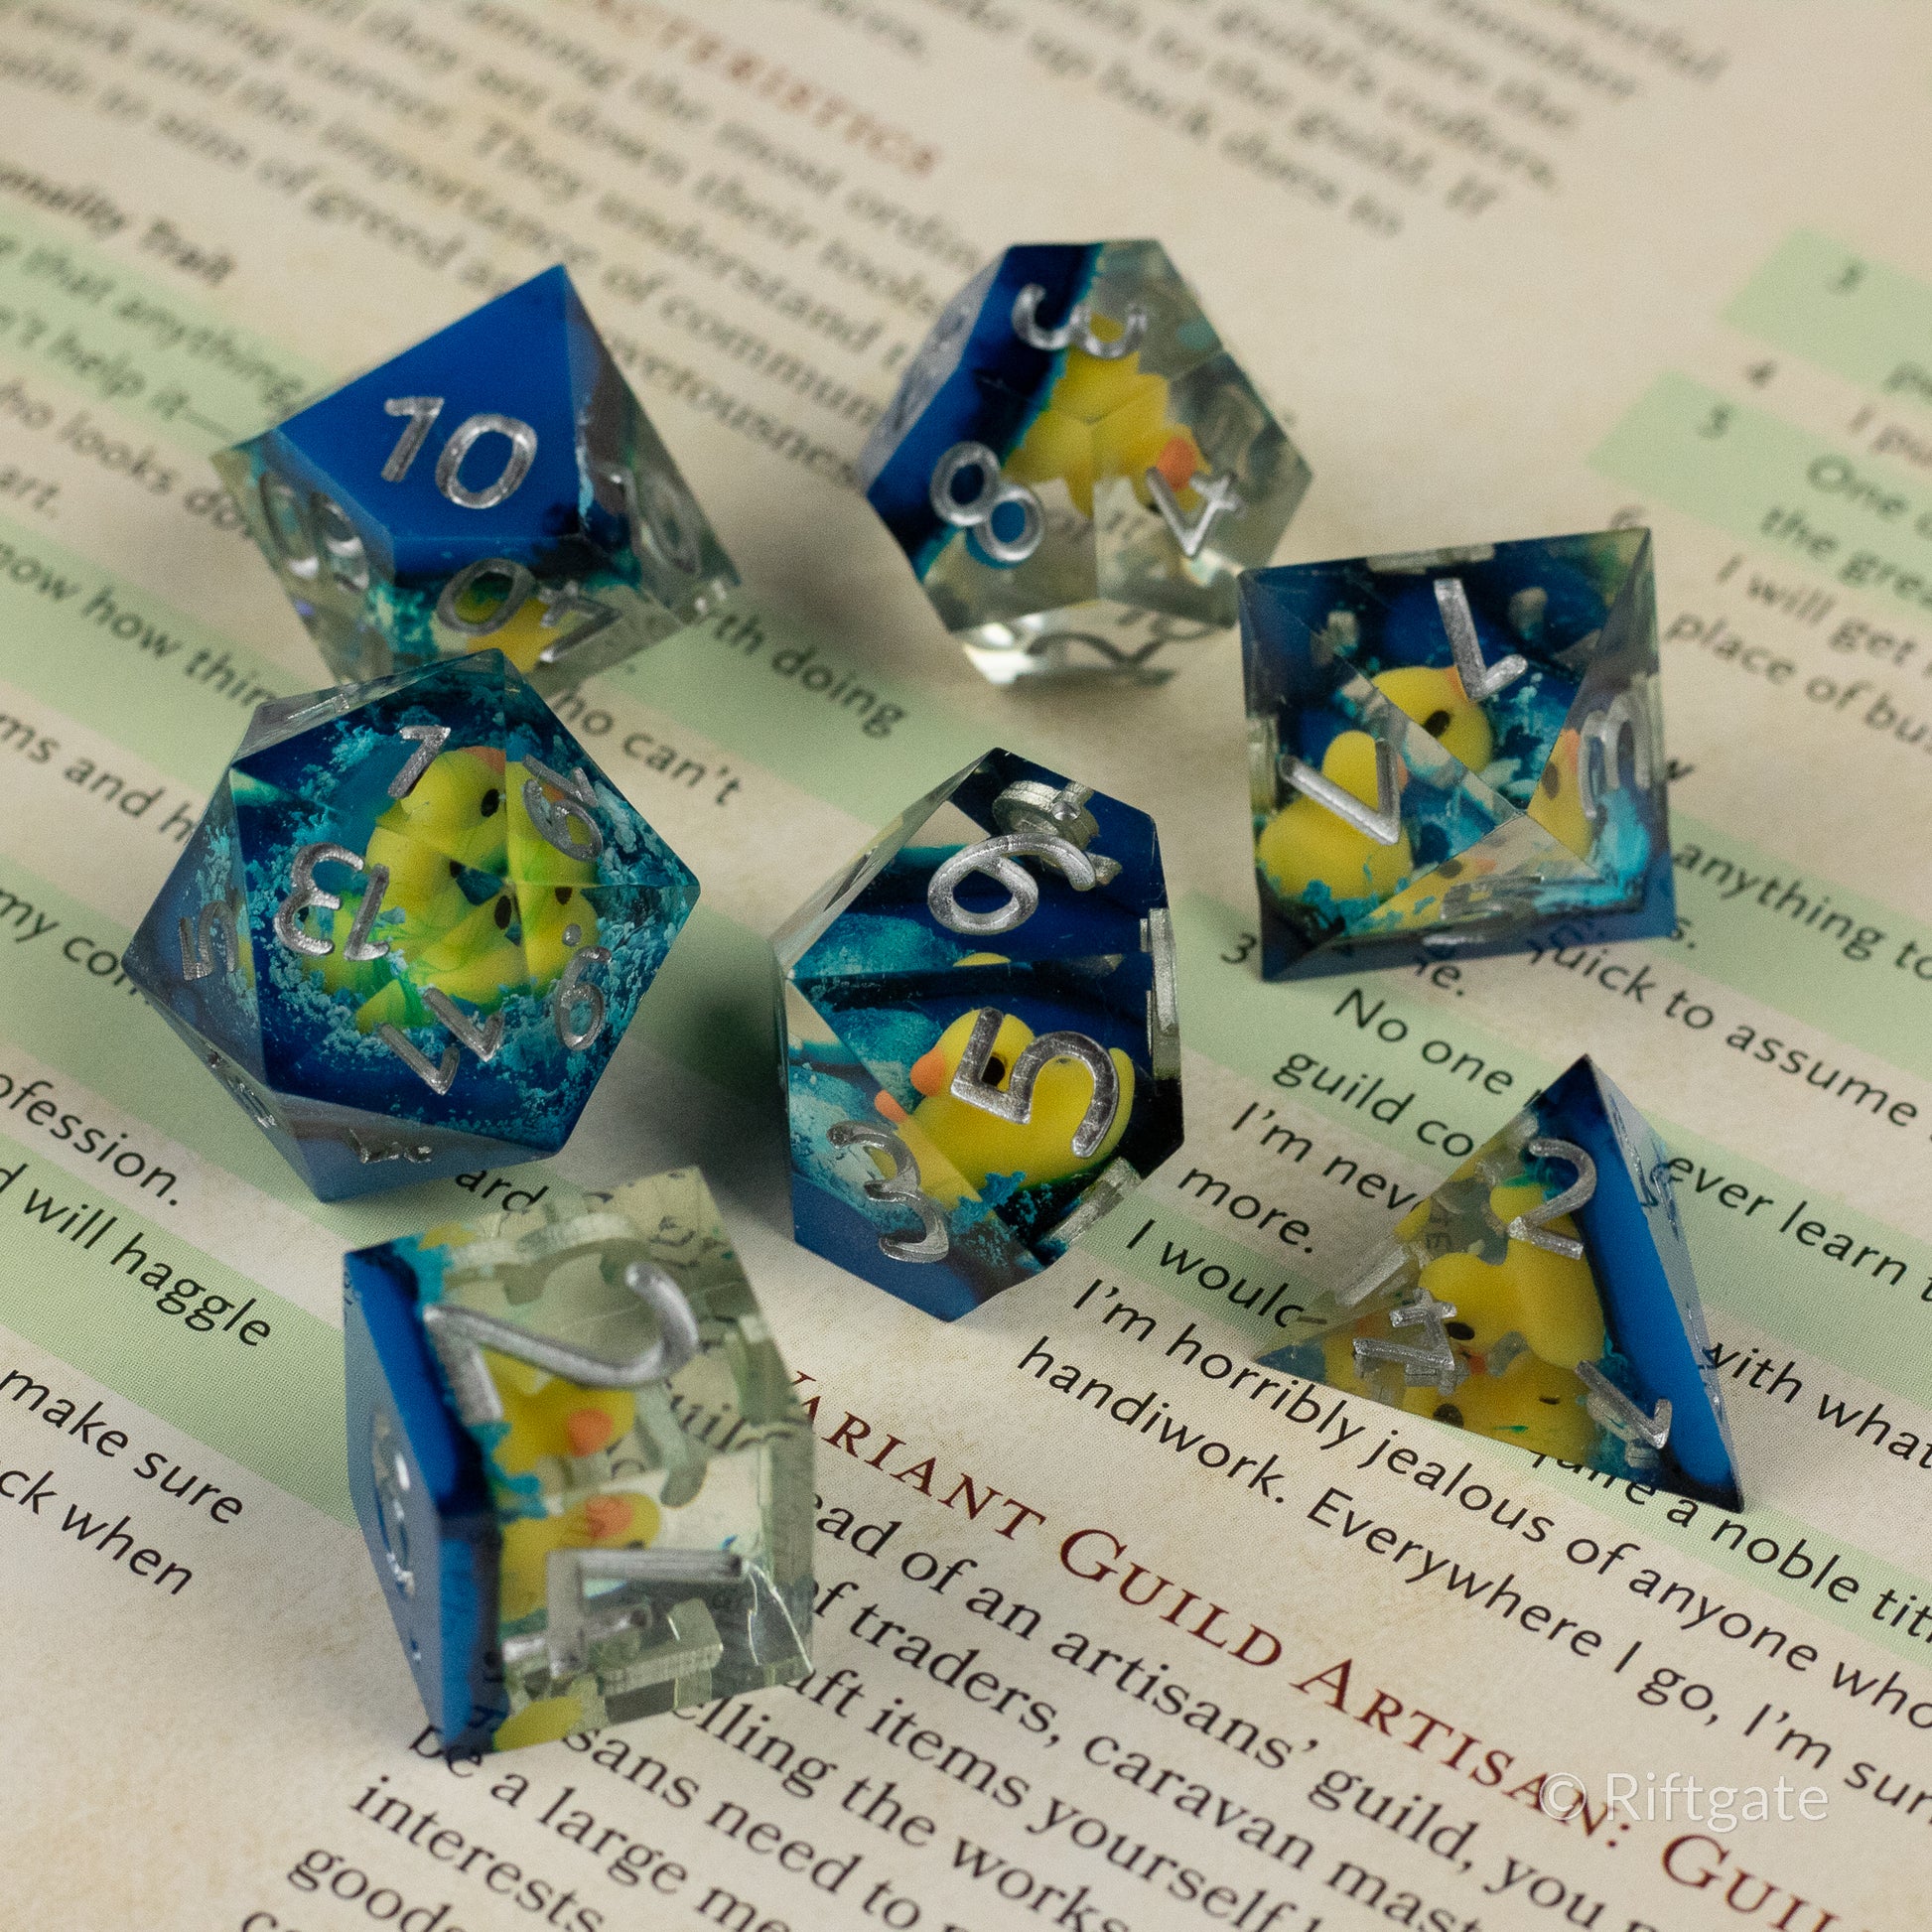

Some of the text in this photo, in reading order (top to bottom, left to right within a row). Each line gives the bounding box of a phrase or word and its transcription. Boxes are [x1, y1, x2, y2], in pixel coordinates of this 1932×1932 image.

[845, 187, 983, 276] ordin
[659, 294, 896, 429] commun
[380, 395, 538, 510] 10
[929, 440, 1046, 563] 8
[1835, 547, 1932, 614] gre
[79, 582, 185, 659] how
[183, 643, 280, 711] thin
[770, 637, 909, 741] doing
[1662, 609, 1799, 688] place
[62, 753, 167, 820] and
[621, 729, 745, 807] can't
[1672, 837, 1888, 965] anything
[949, 1006, 1121, 1160] 5
[1218, 929, 1258, 966] 3
[1333, 987, 1410, 1043] No
[1421, 1037, 1515, 1097] one
[1778, 1199, 1909, 1289] learn
[1272, 1050, 1476, 1160] guild co
[1663, 987, 1717, 1033] to
[1725, 1021, 1920, 1130] assume
[0, 1070, 181, 1207] ofession.
[825, 1118, 950, 1264] 3
[1321, 1154, 1423, 1212] nev
[1508, 1137, 1597, 1261] 2
[24, 1187, 273, 1348] will haggle
[1125, 1217, 1157, 1251] I
[1177, 1167, 1315, 1255] more.
[422, 1259, 701, 1427] 2
[0, 1368, 244, 1525] make sure
[1165, 1321, 1367, 1451] horribly
[1356, 1428, 1557, 1545] jealous
[1565, 1537, 1642, 1578] of
[1627, 1567, 1820, 1674] anyone
[0, 1468, 194, 1596] ck when
[1017, 1334, 1286, 1505] handiwork.
[1307, 1484, 1604, 1658] Everywhere
[1611, 1639, 1644, 1675] I
[1636, 1664, 1721, 1727] go,
[1843, 1760, 1932, 1821] sur
[1710, 1517, 1861, 1604] noble
[1871, 1588, 1932, 1644] tit
[848, 1599, 1062, 1751] traders,
[1082, 1732, 1334, 1873] caravan
[863, 1696, 1033, 1811] items
[900, 1556, 979, 1595] of
[964, 1586, 1045, 1641] an
[1050, 1628, 1319, 1771] artisans'
[1307, 1751, 1476, 1875] guild,
[1482, 1854, 1608, 1932] you
[348, 1773, 607, 1932] interests
[489, 1771, 531, 1809] a
[535, 1786, 691, 1896] large
[560, 1727, 923, 1932] sans need to
[839, 1772, 938, 1850] the
[286, 1848, 467, 1932] good
